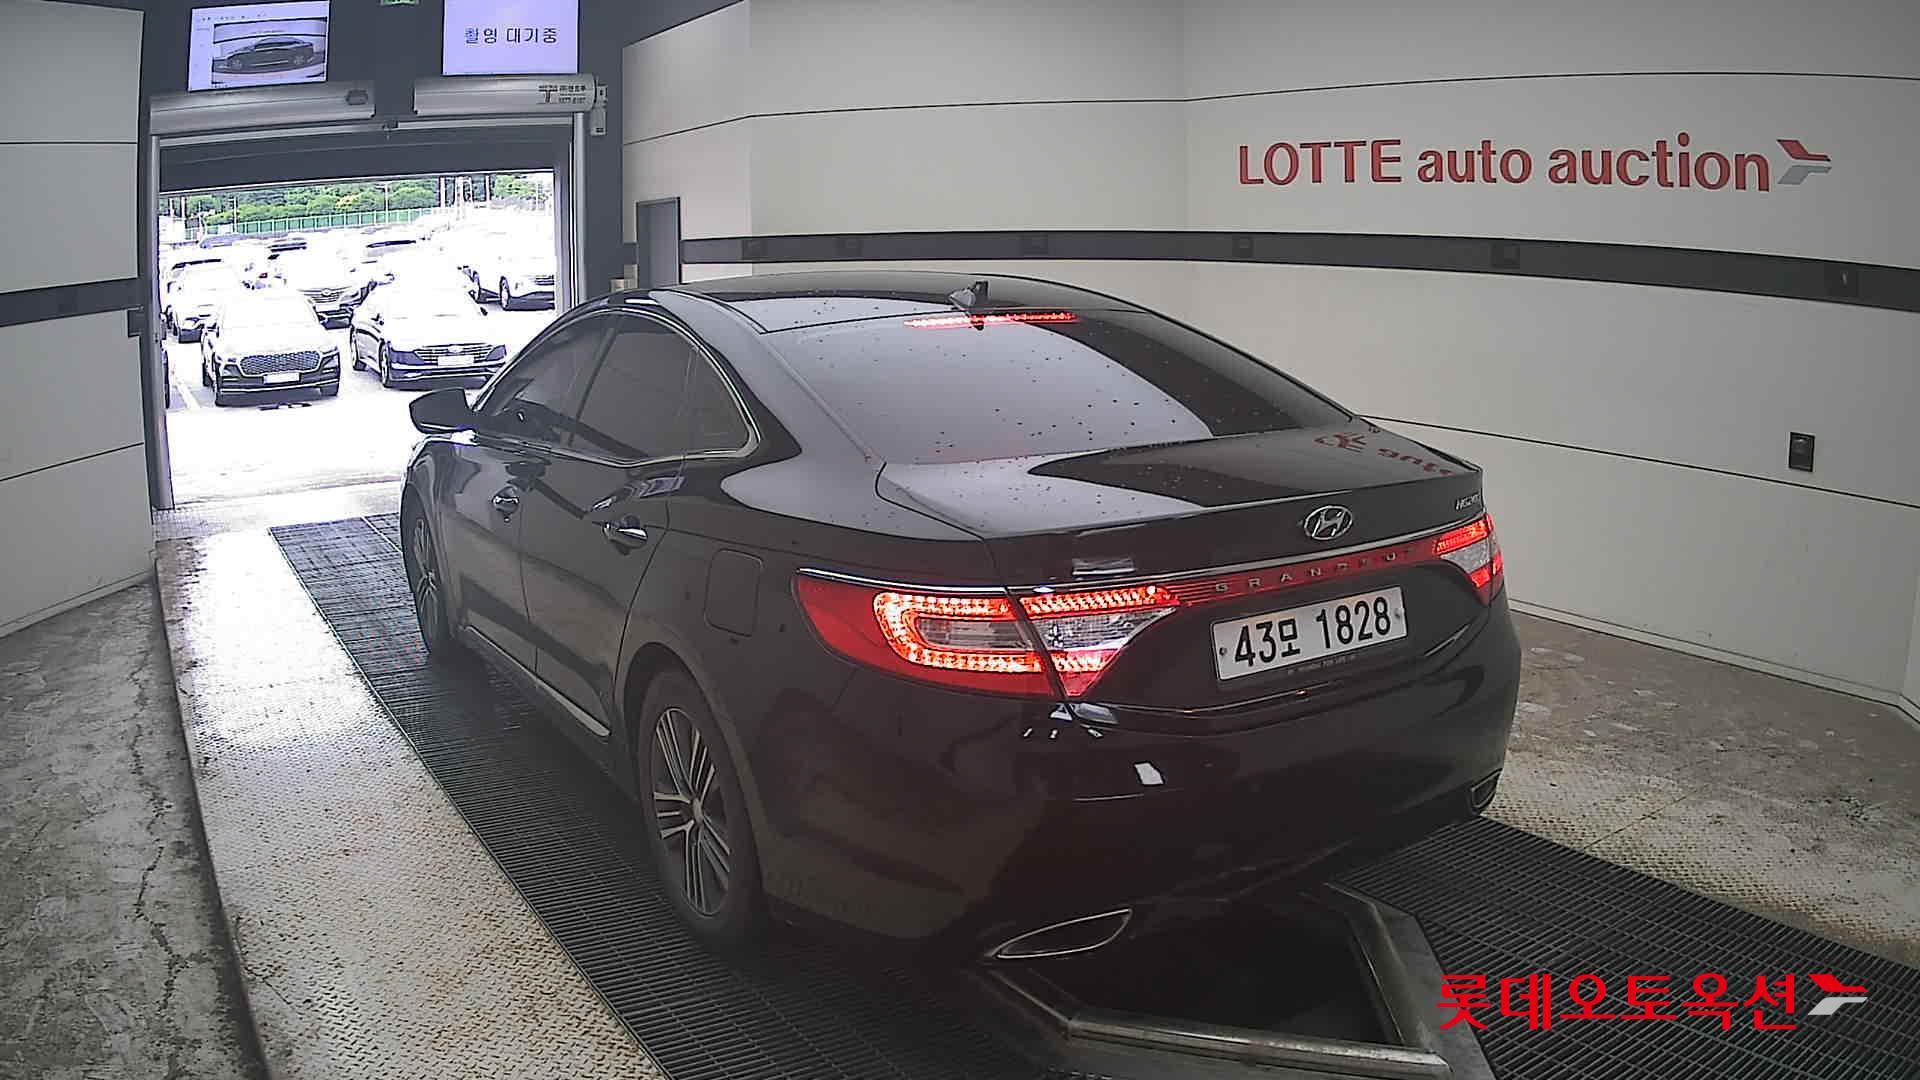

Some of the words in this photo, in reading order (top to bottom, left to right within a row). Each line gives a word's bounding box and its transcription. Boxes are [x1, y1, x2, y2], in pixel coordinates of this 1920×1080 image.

[506, 27, 557, 44] 대기중
[1239, 139, 1402, 186] LOTTE
[1417, 140, 1532, 185] auto
[1548, 132, 1770, 192] auction
[1215, 548, 1412, 592] GRANDU
[1235, 617, 1301, 667] 43모
[1315, 597, 1391, 649] 1828
